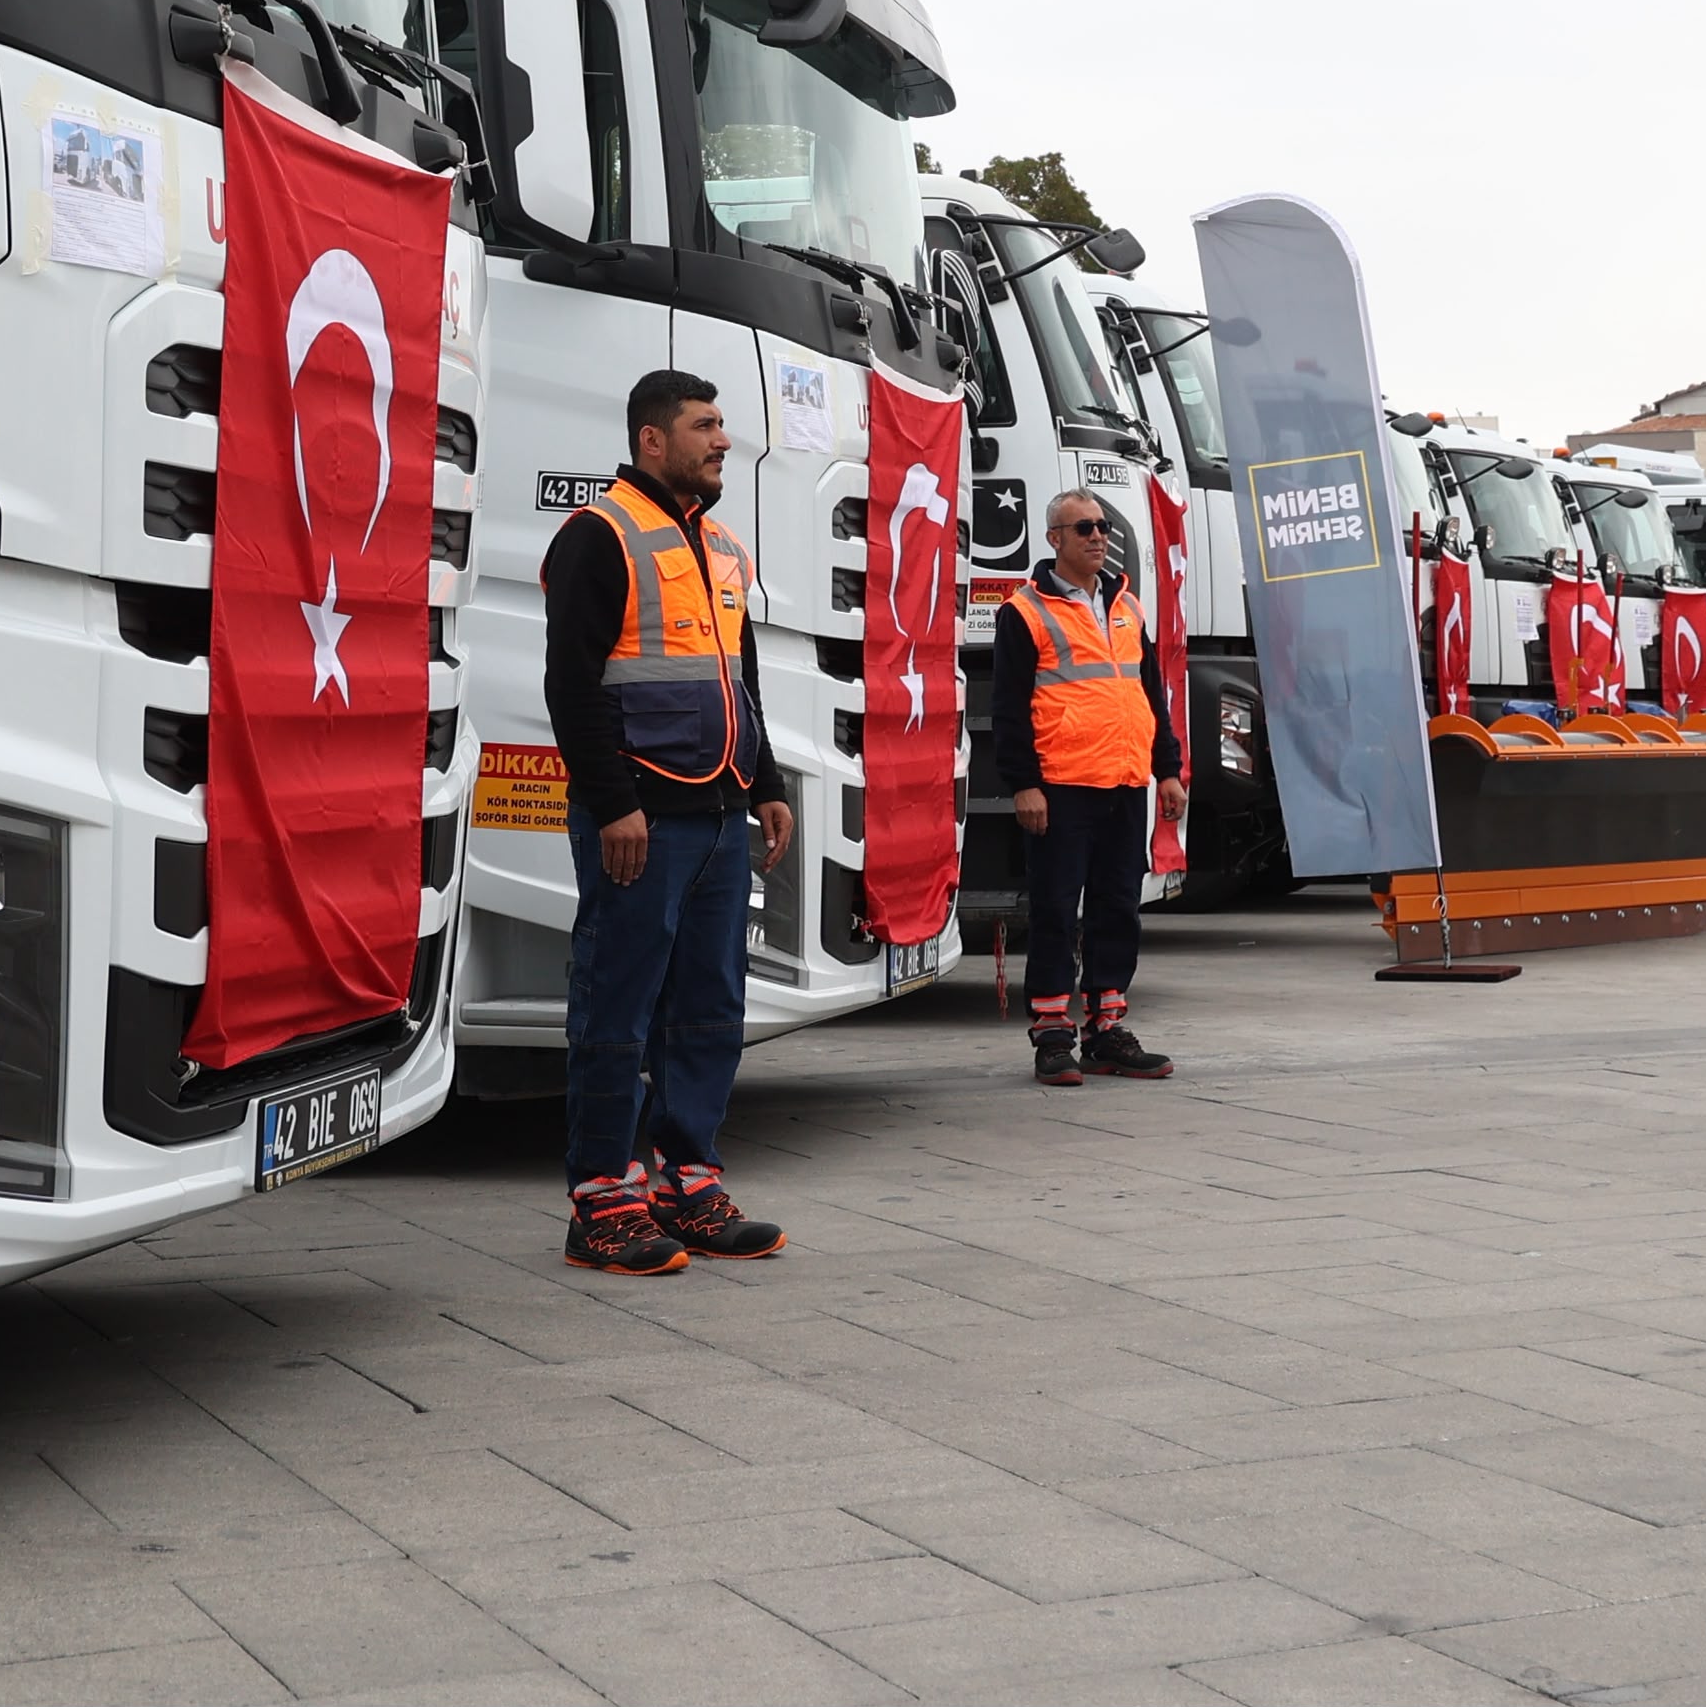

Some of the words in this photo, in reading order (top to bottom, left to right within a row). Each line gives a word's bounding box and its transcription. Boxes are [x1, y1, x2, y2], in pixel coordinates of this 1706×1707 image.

[1088, 465, 1101, 482] 42
[543, 479, 569, 504] 42
[573, 481, 608, 505] BIE
[968, 608, 991, 616] LANDA
[479, 748, 567, 778] DİKKAT
[511, 783, 551, 794] ARACIN
[487, 795, 509, 807] KÖR
[511, 798, 567, 811] NOKTASIDI
[475, 811, 509, 824] ŞOFÖR
[511, 812, 531, 825] SİZİ
[273, 1104, 297, 1162] 42
[307, 1090, 338, 1151] BIE
[349, 1078, 377, 1135] 069
[263, 1143, 273, 1160] TR
